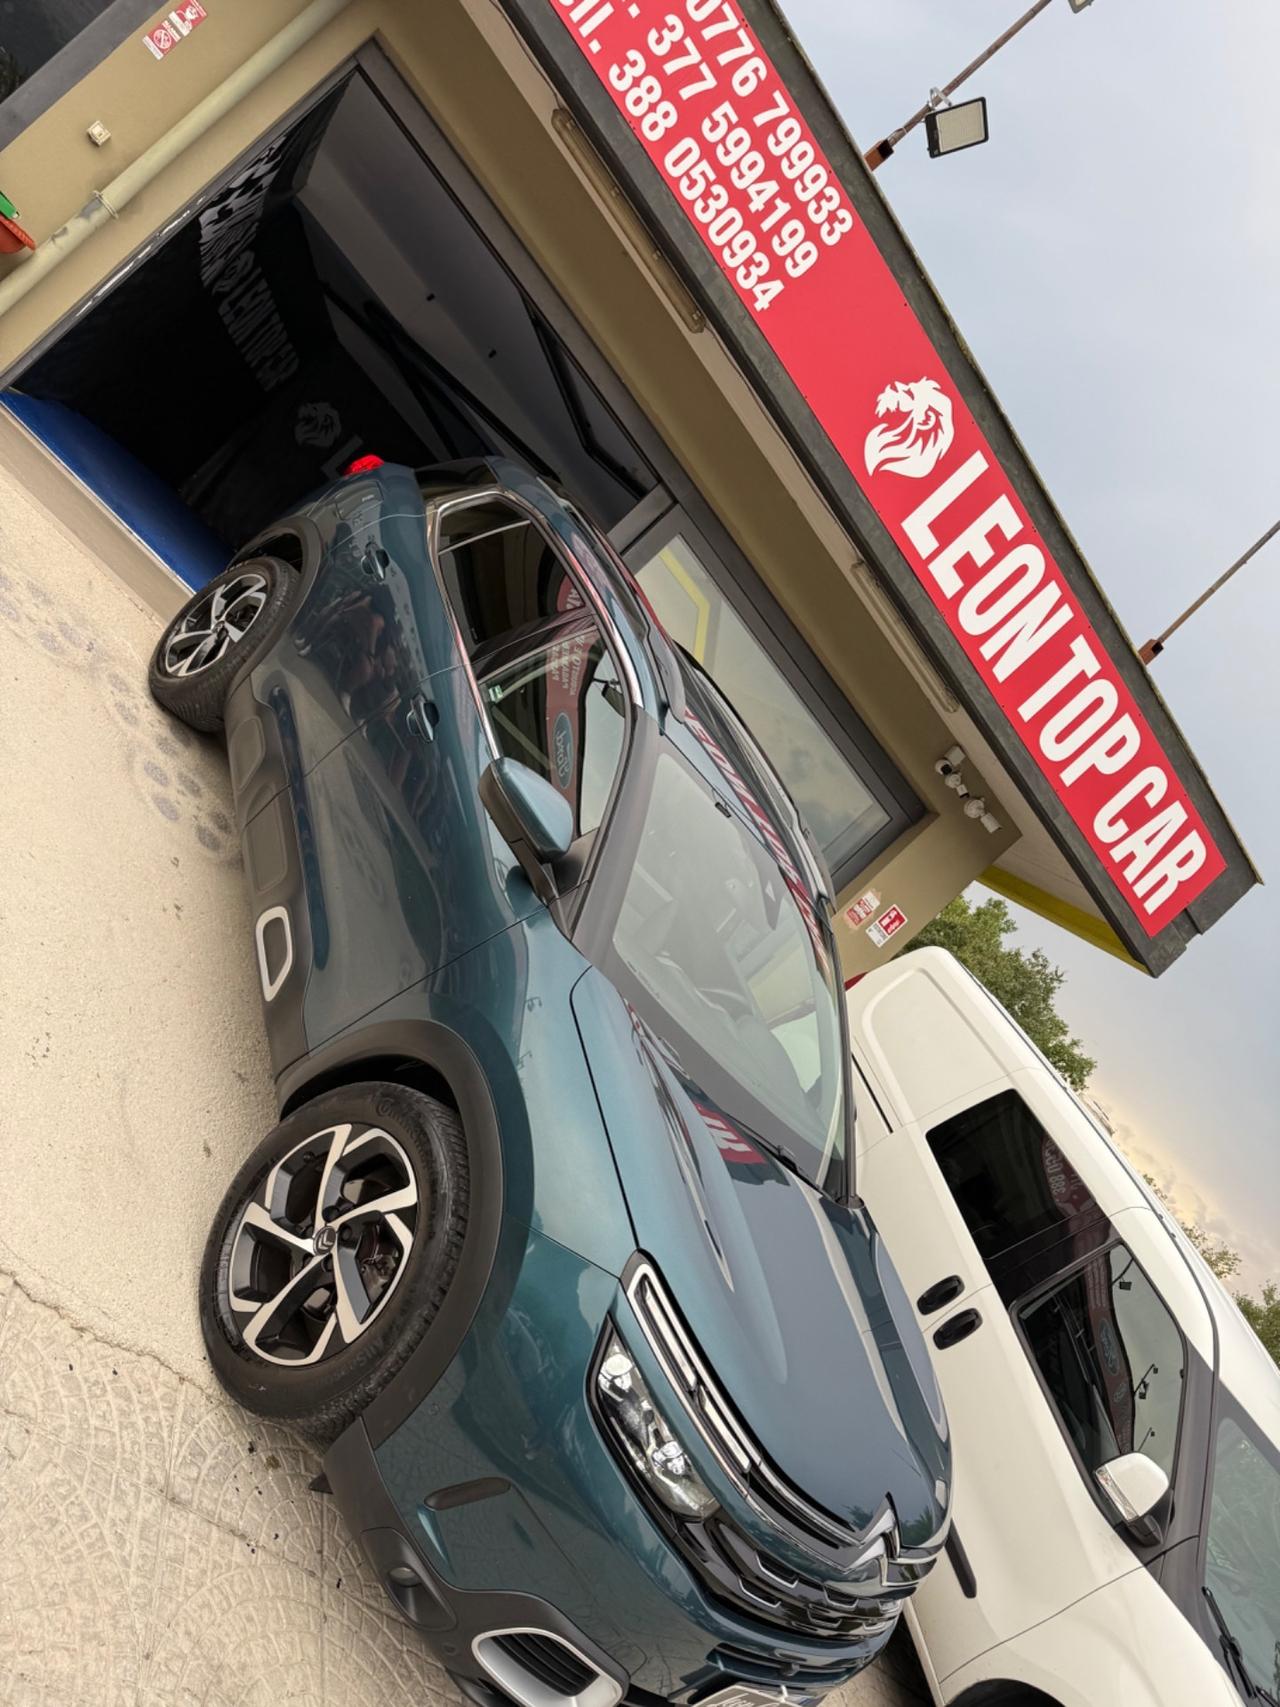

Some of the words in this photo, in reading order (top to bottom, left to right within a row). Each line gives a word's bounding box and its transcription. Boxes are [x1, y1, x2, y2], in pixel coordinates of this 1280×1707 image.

[608, 49, 678, 142] 388
[663, 136, 785, 312] 0530934
[647, 13, 718, 101] 377
[701, 101, 819, 278] 5994199
[752, 90, 853, 246] 799933
[900, 450, 1074, 683] LEON
[1017, 634, 1141, 787] TOP
[1093, 765, 1207, 915] CAR
